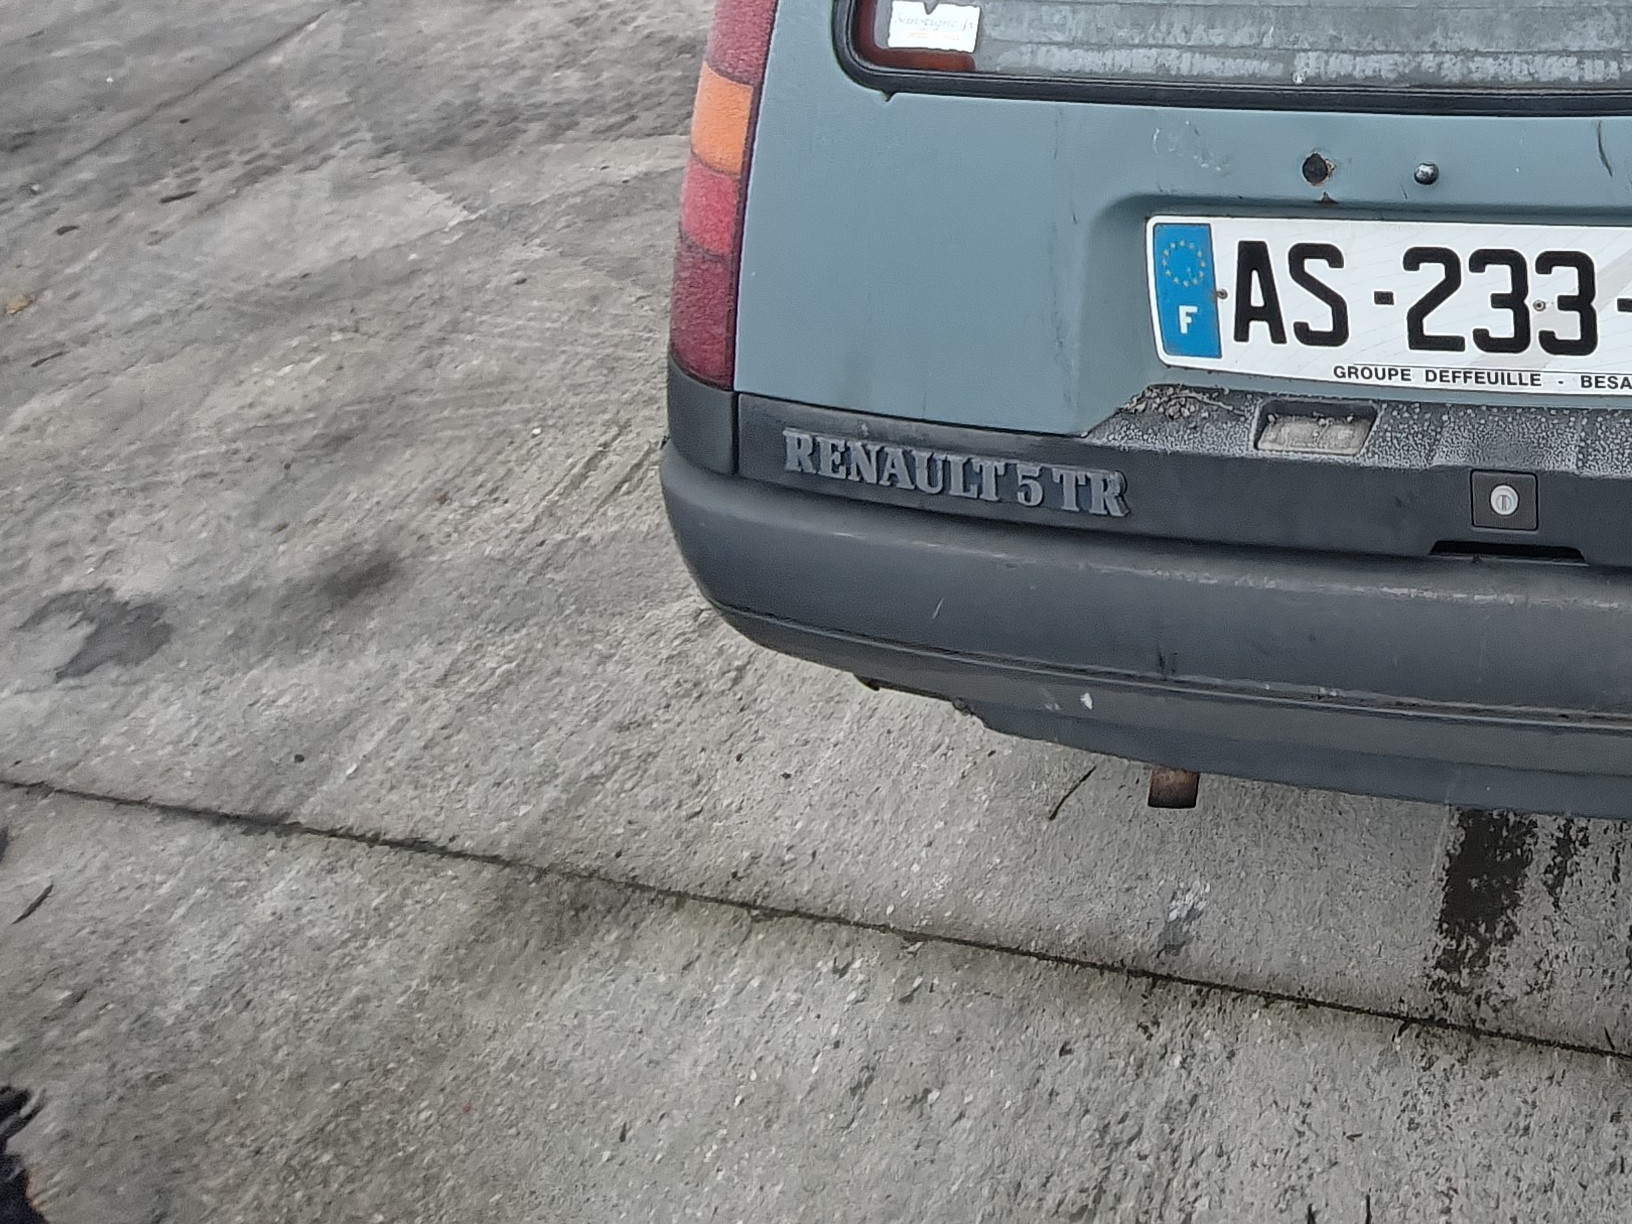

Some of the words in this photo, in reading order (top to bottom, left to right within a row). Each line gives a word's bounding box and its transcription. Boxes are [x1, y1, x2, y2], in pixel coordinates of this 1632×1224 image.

[1178, 305, 1198, 334] F
[1333, 365, 1412, 382] GROUPE
[1425, 369, 1542, 387] DEFFEUILLE
[783, 427, 1005, 503] RENAULT
[1015, 460, 1045, 507] 5
[1051, 463, 1131, 518] TR
